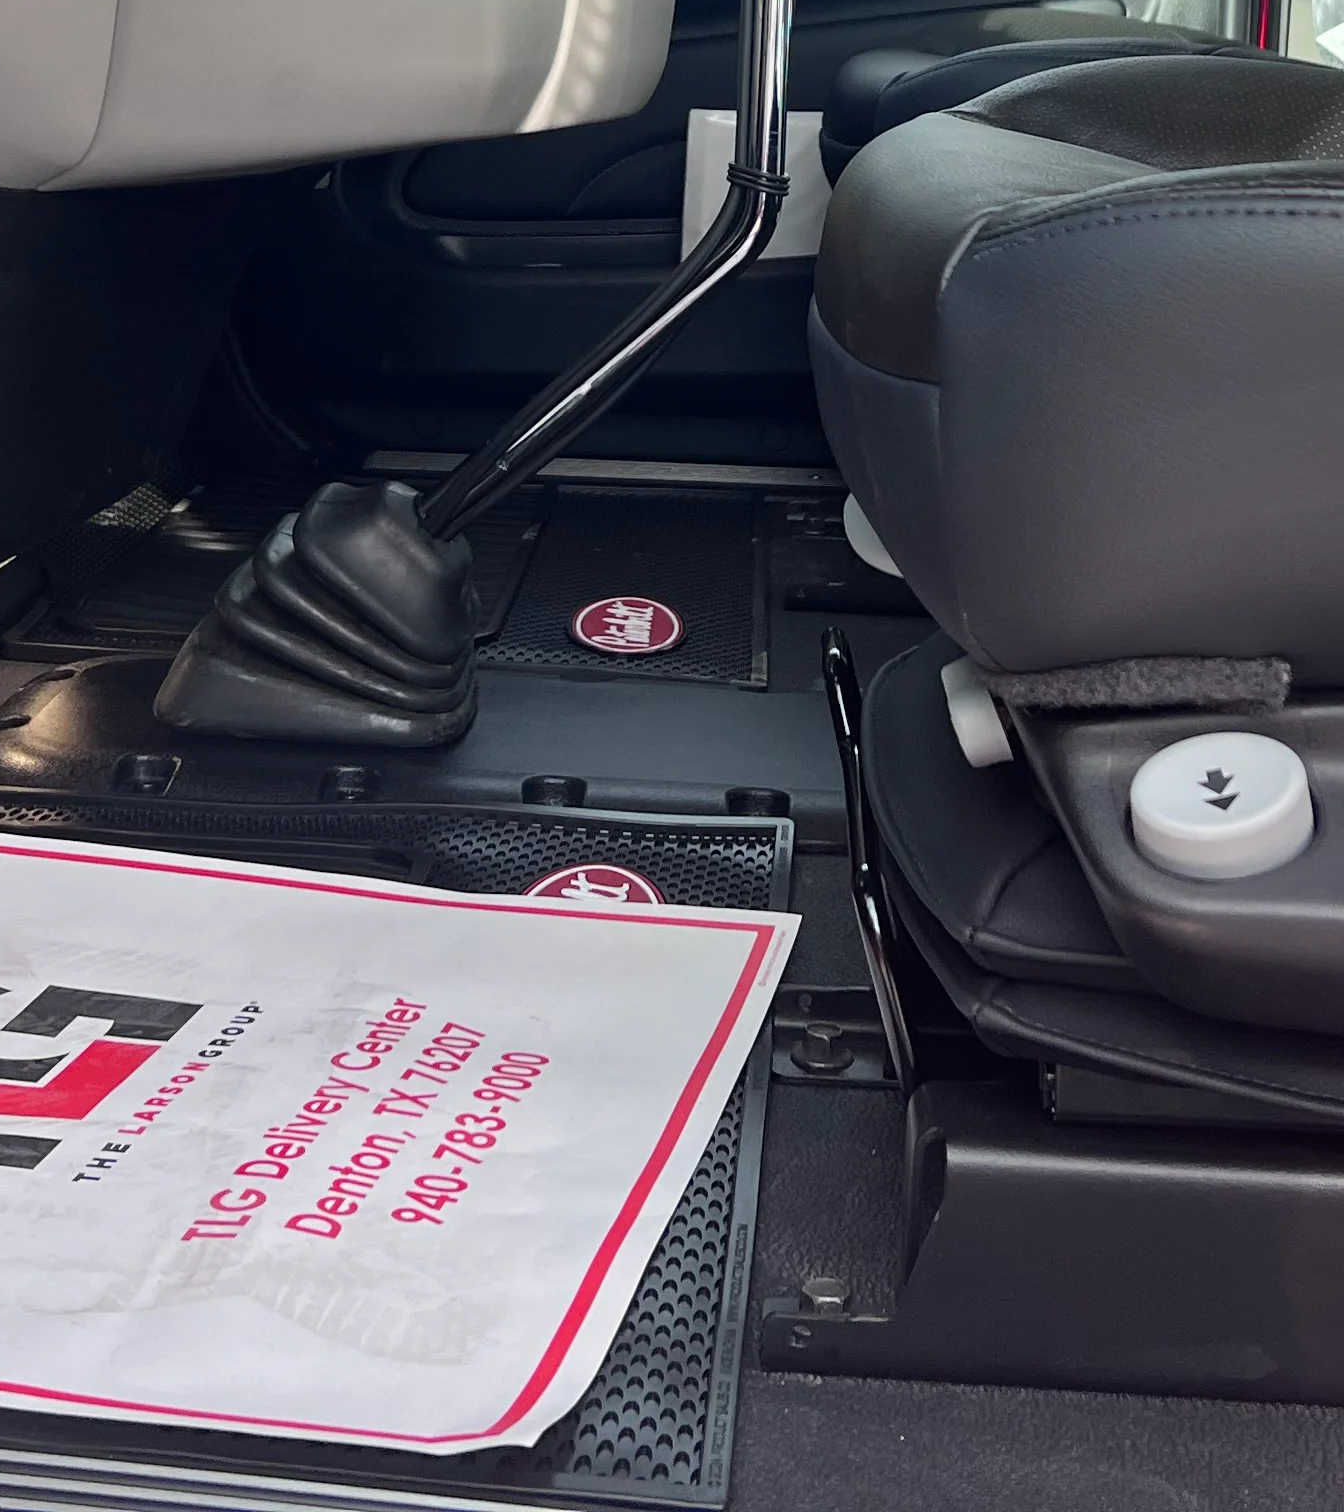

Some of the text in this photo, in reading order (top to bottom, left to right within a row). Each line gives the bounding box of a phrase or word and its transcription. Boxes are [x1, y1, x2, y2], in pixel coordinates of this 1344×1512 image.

[72, 1002, 265, 1182] THE LARSON GROUP
[180, 996, 428, 1242] TLG Delivery Center
[283, 1021, 487, 1240] Denton, TX 76207
[390, 1050, 550, 1226] 940-783-9000
